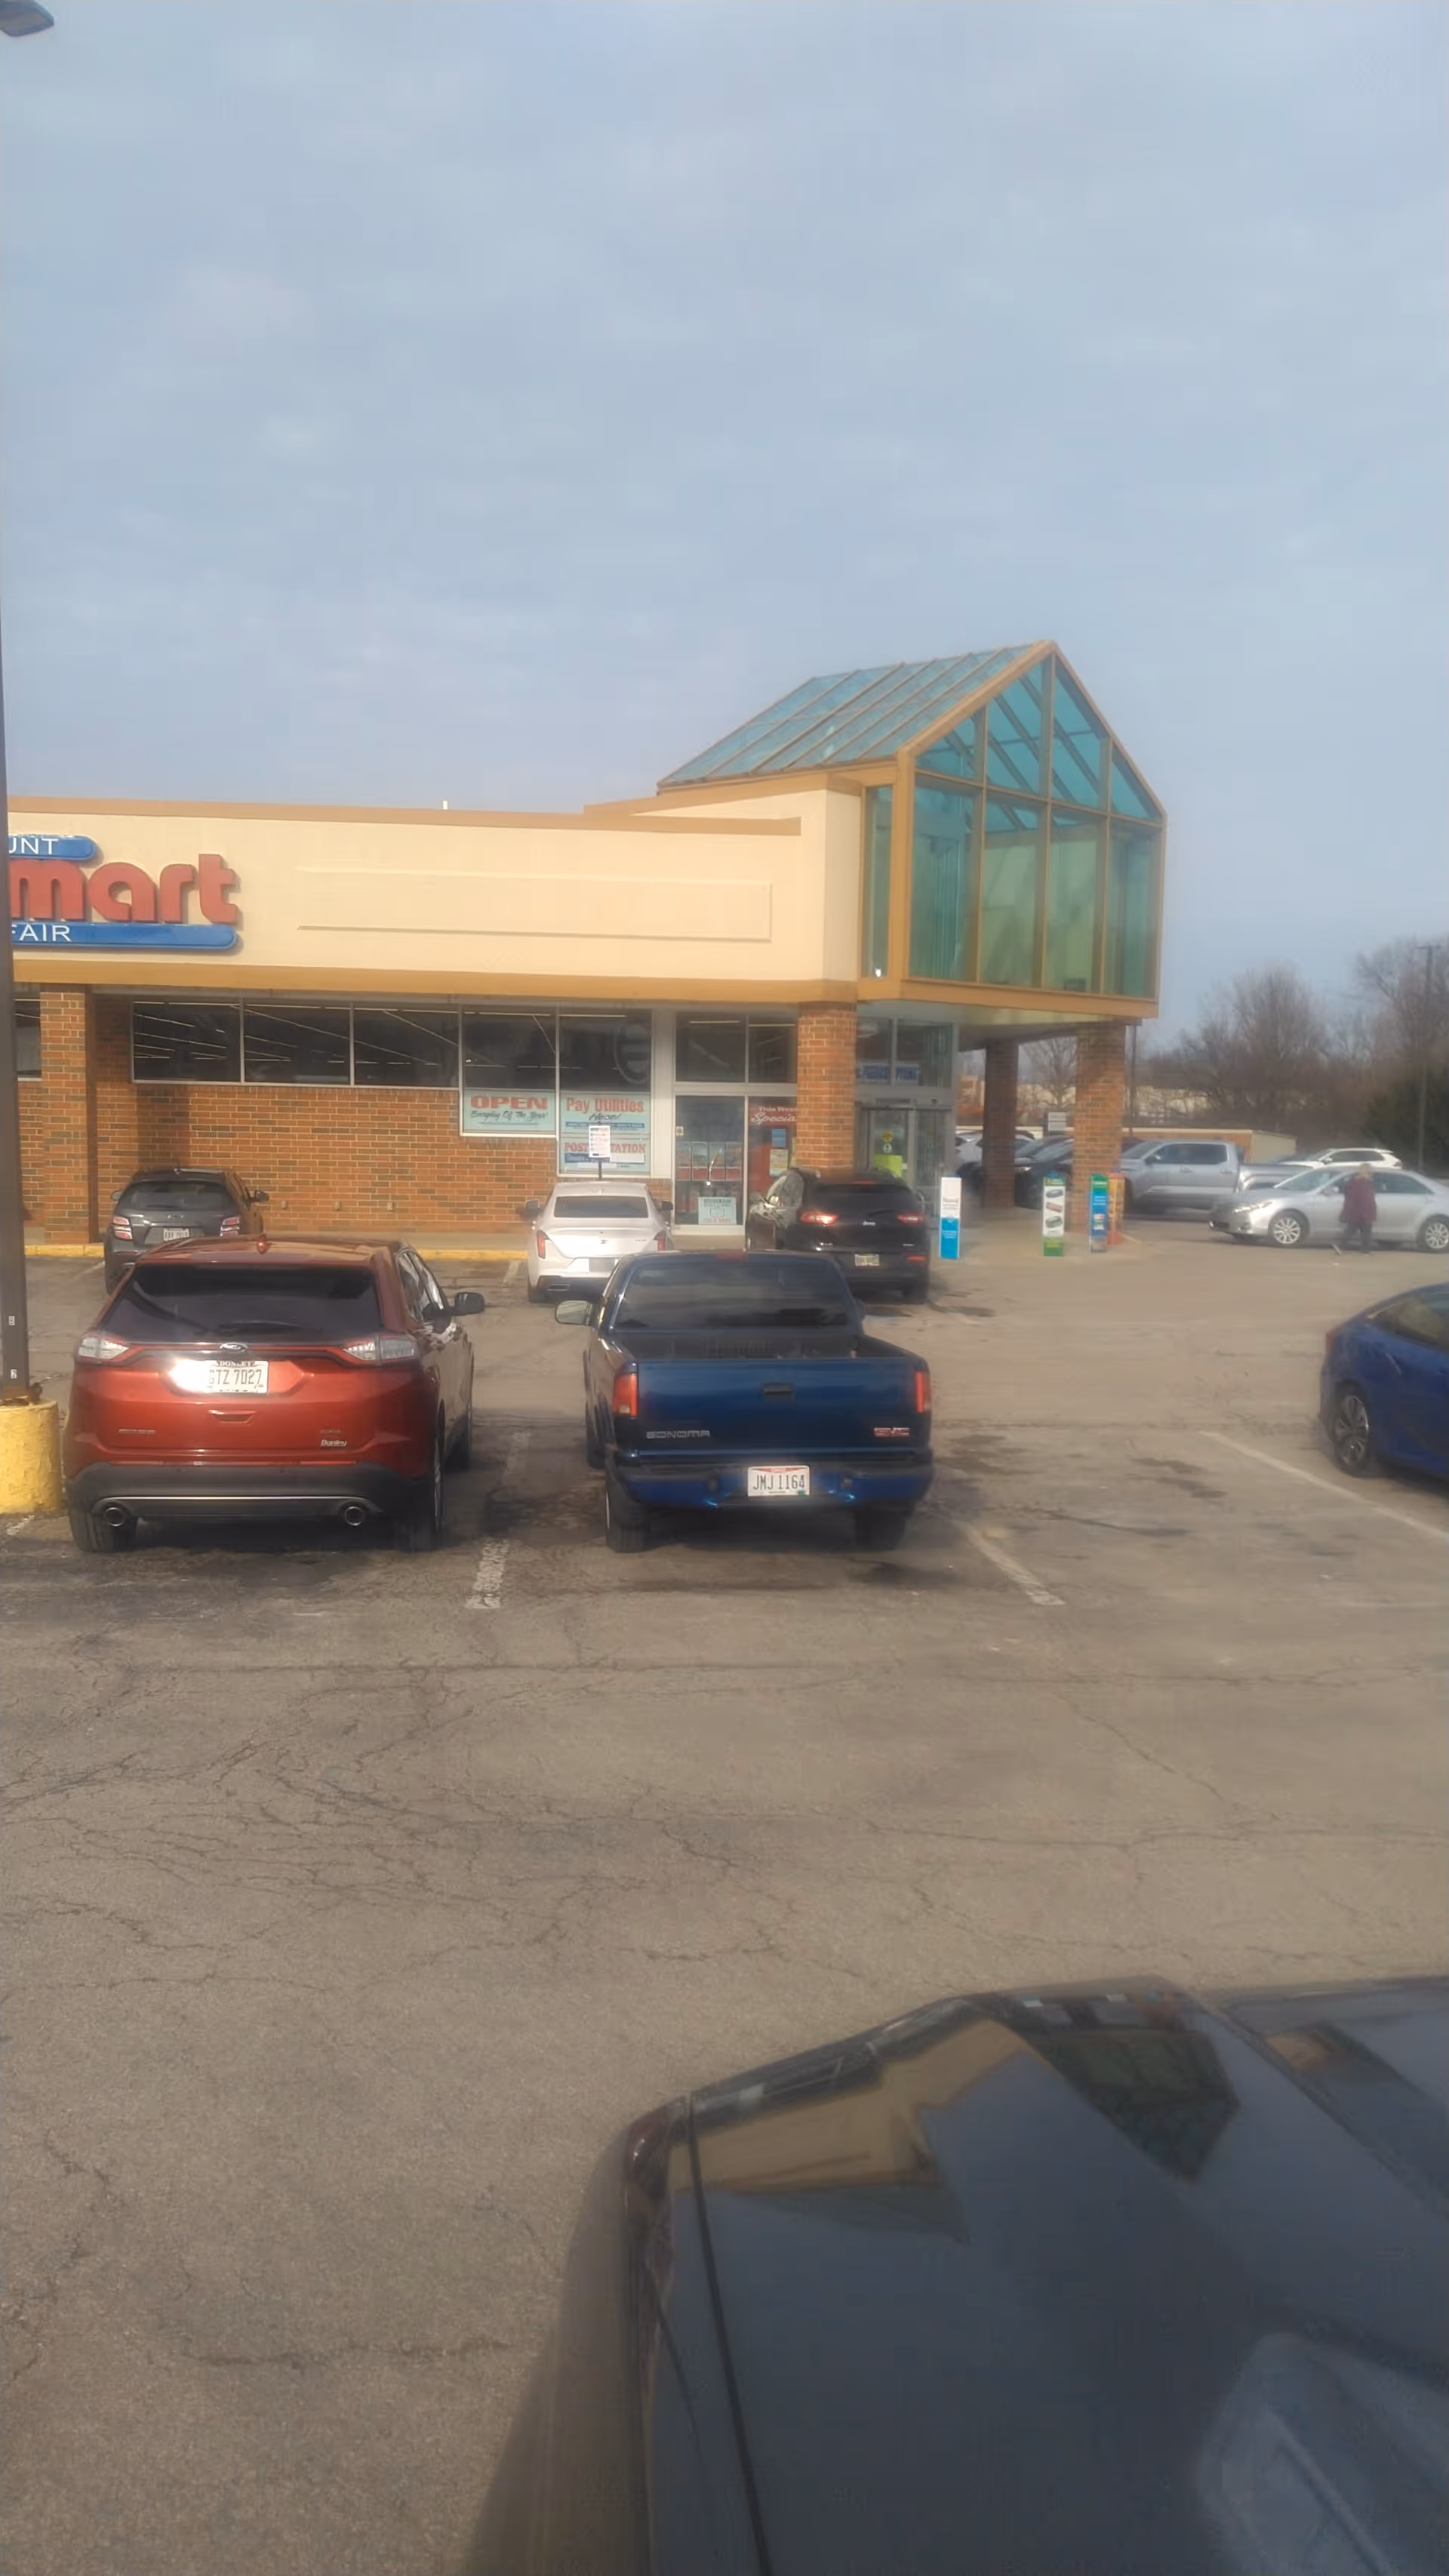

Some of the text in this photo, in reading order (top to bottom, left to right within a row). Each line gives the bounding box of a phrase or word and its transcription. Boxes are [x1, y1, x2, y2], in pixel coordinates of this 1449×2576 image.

[10, 854, 236, 923] mart
[470, 1095, 548, 1110] OPEN
[566, 1097, 645, 1114] Pay Utilities
[751, 1111, 797, 1125] Specia
[564, 1142, 647, 1153] POST TATION
[209, 1369, 262, 1385] GTZ 7027
[646, 1430, 710, 1439] SONOMA
[753, 1474, 804, 1490] JMJ 1164
